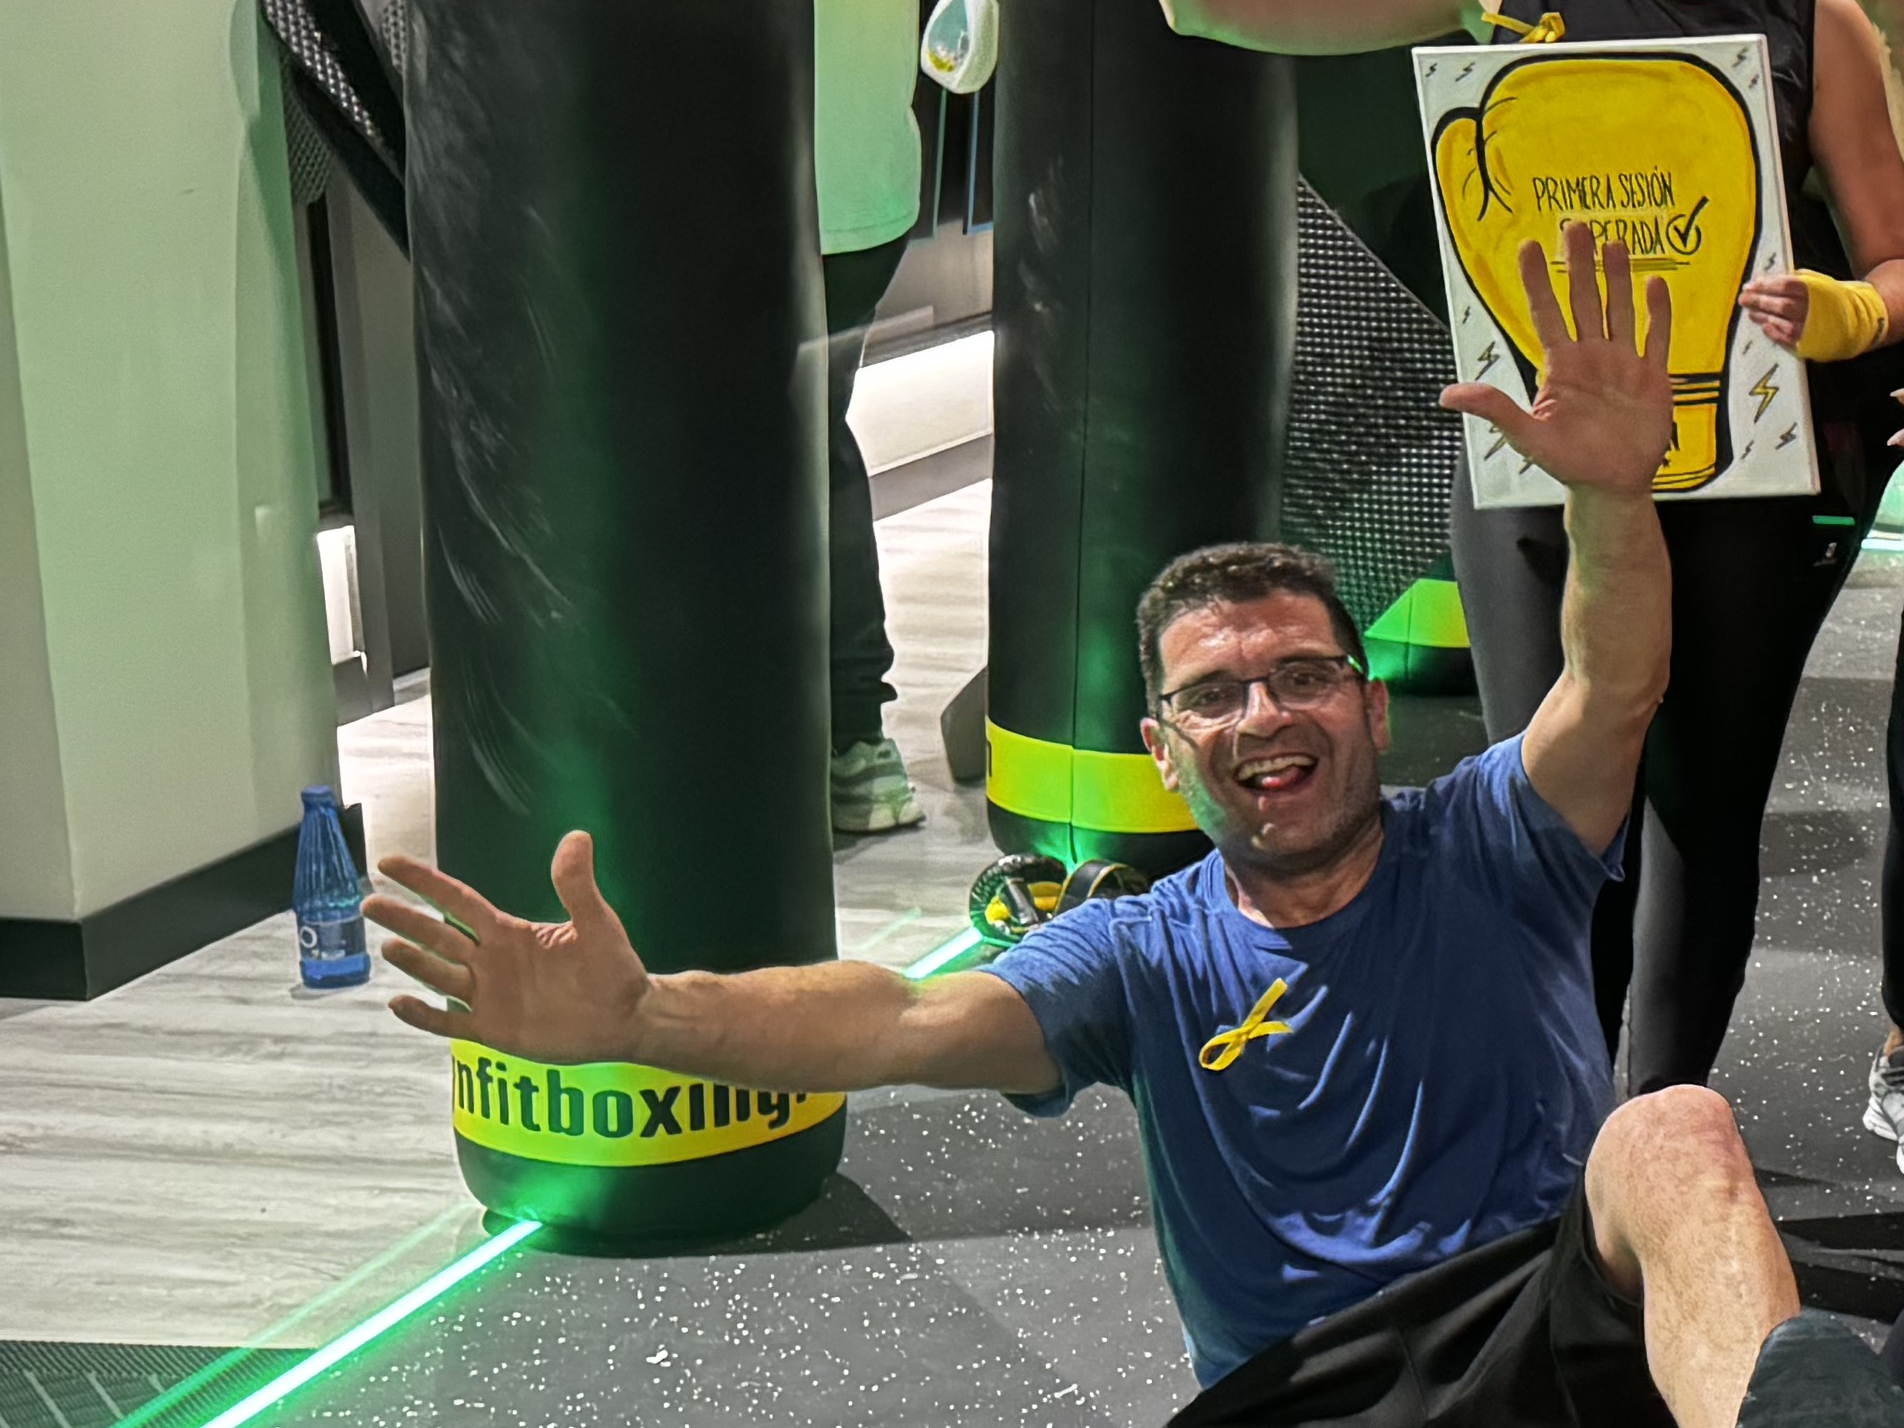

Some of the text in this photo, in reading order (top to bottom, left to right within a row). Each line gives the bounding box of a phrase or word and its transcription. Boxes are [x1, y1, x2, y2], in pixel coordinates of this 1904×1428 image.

[1532, 164, 1675, 212] PRIMERA SESIÓN
[1559, 216, 1666, 256] PERADA
